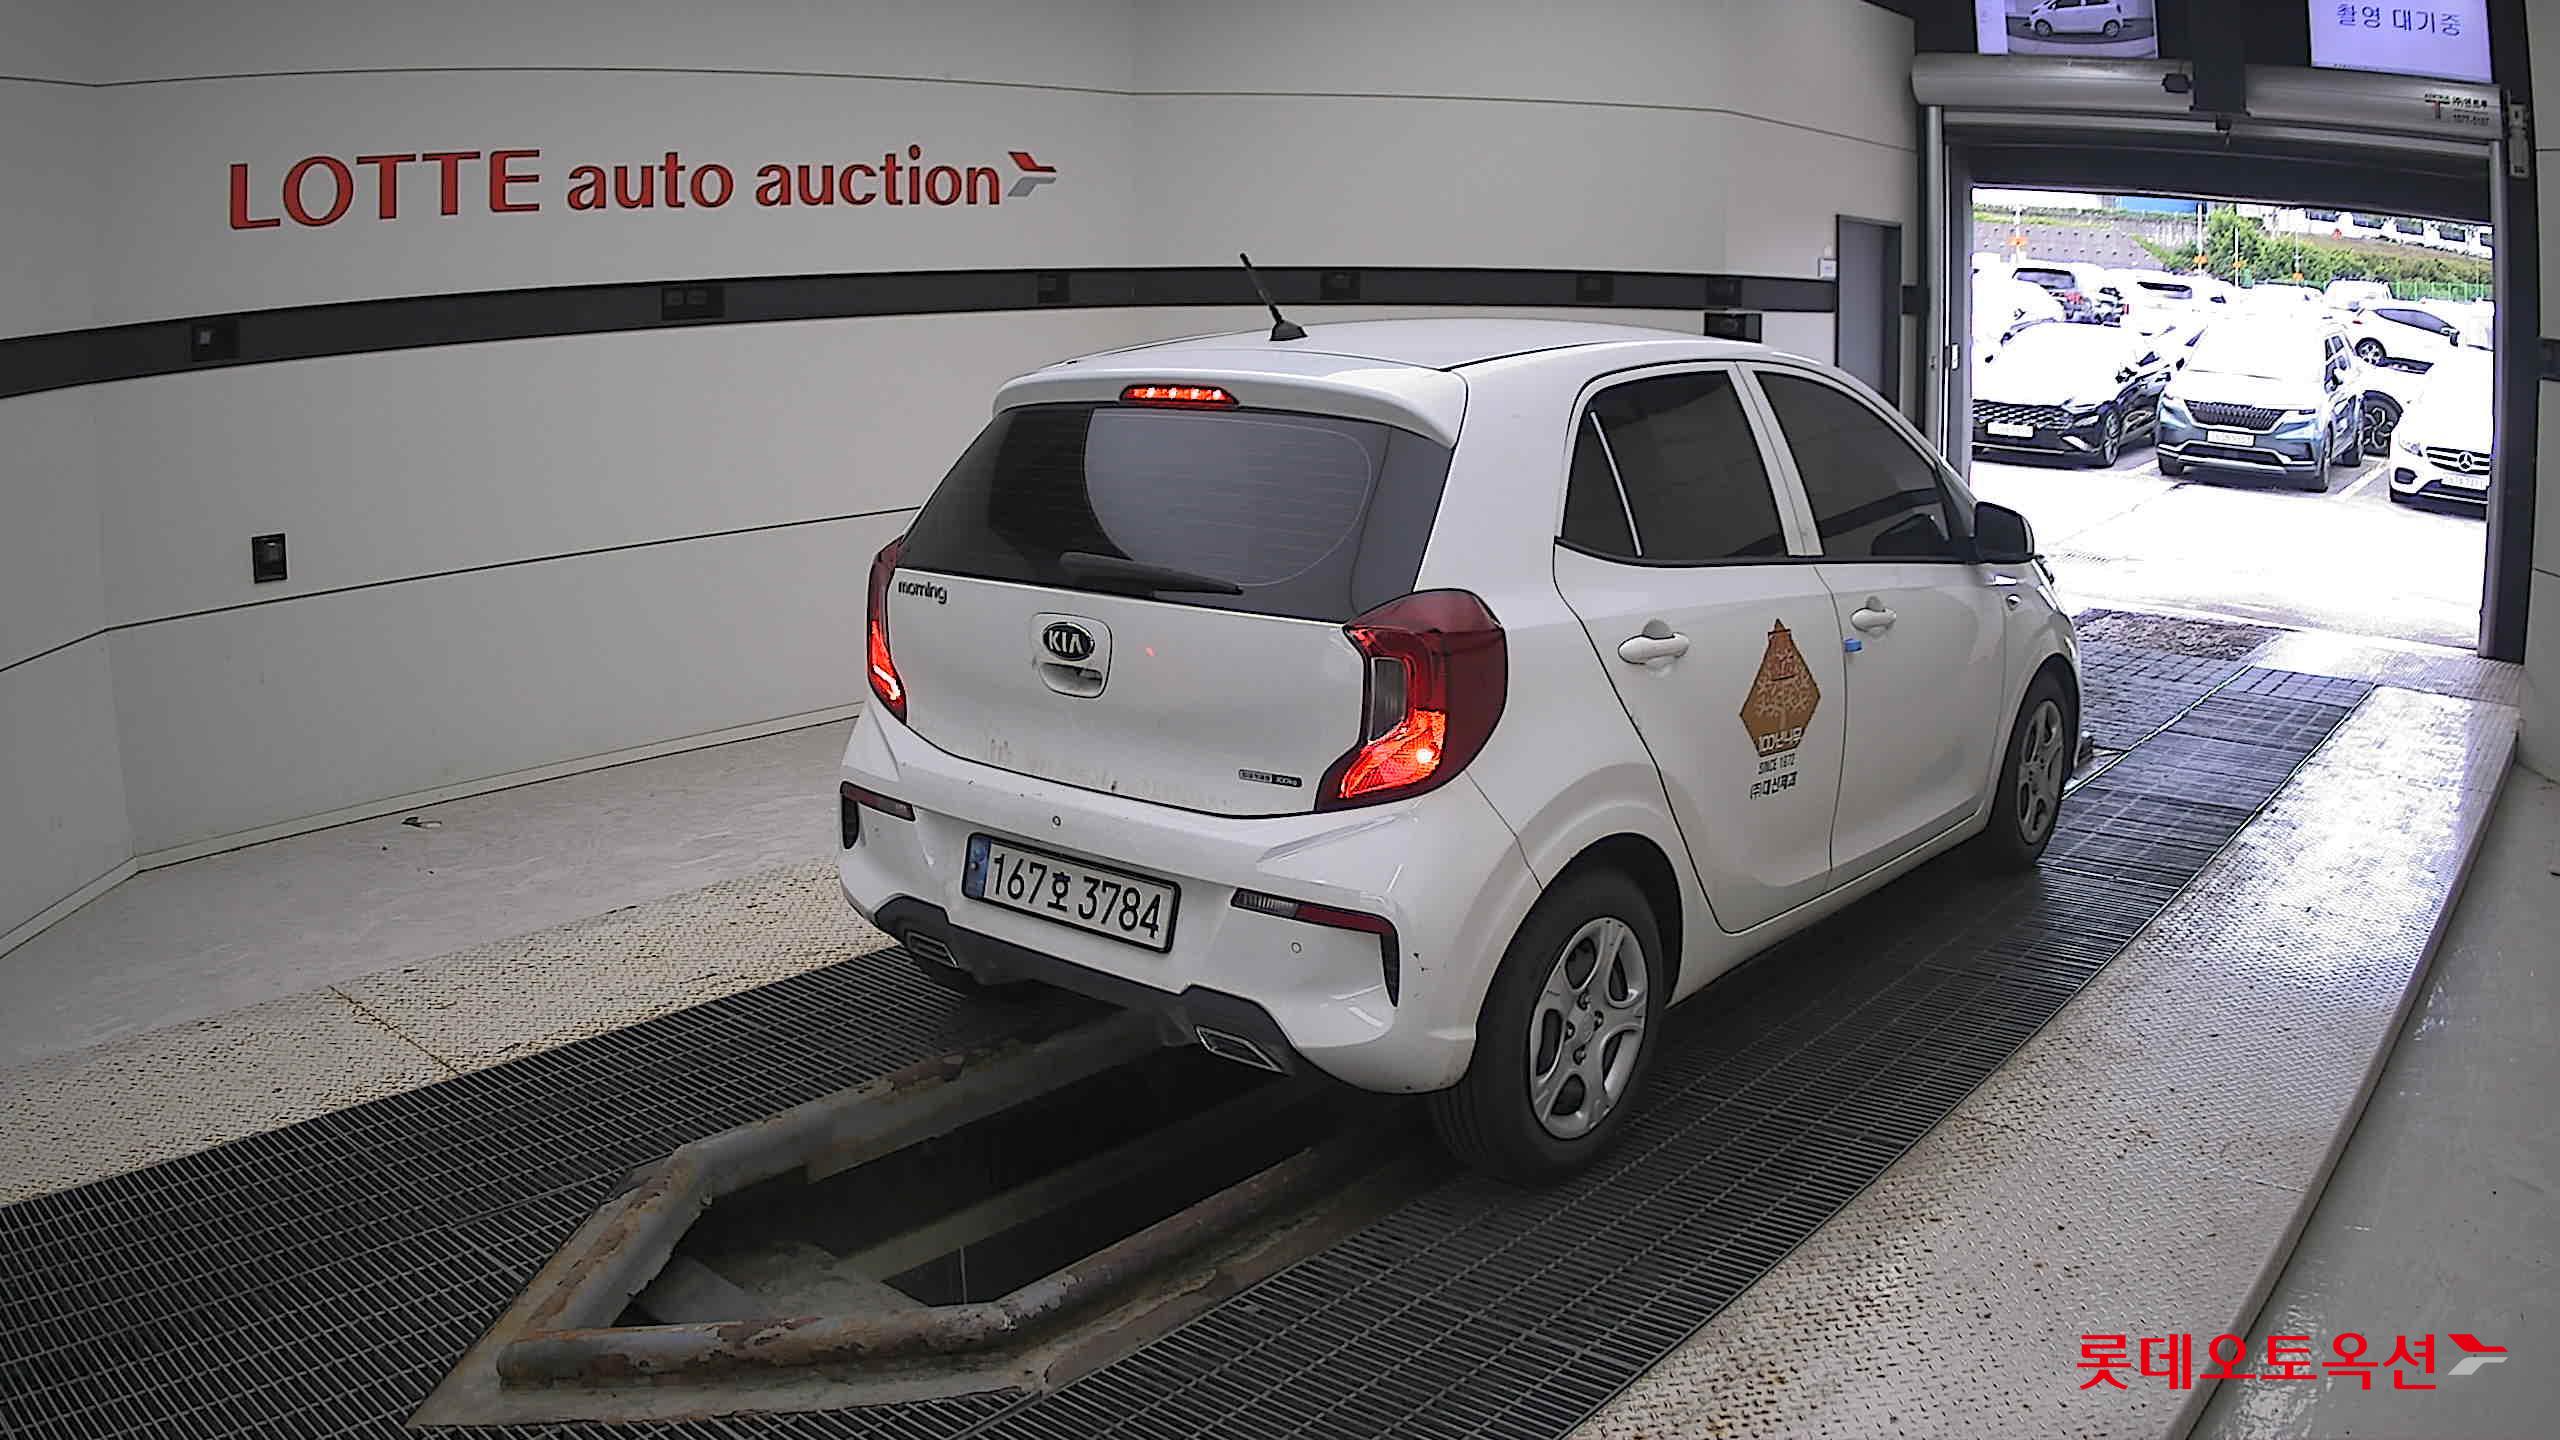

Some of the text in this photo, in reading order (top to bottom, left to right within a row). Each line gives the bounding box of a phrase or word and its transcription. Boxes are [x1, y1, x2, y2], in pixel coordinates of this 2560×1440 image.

[2337, 3, 2461, 36] 촬영 대기중
[228, 144, 1001, 231] LOTTE auto auction
[898, 580, 948, 605] morning
[1048, 629, 1084, 655] KIA
[1078, 875, 1161, 939] 3784
